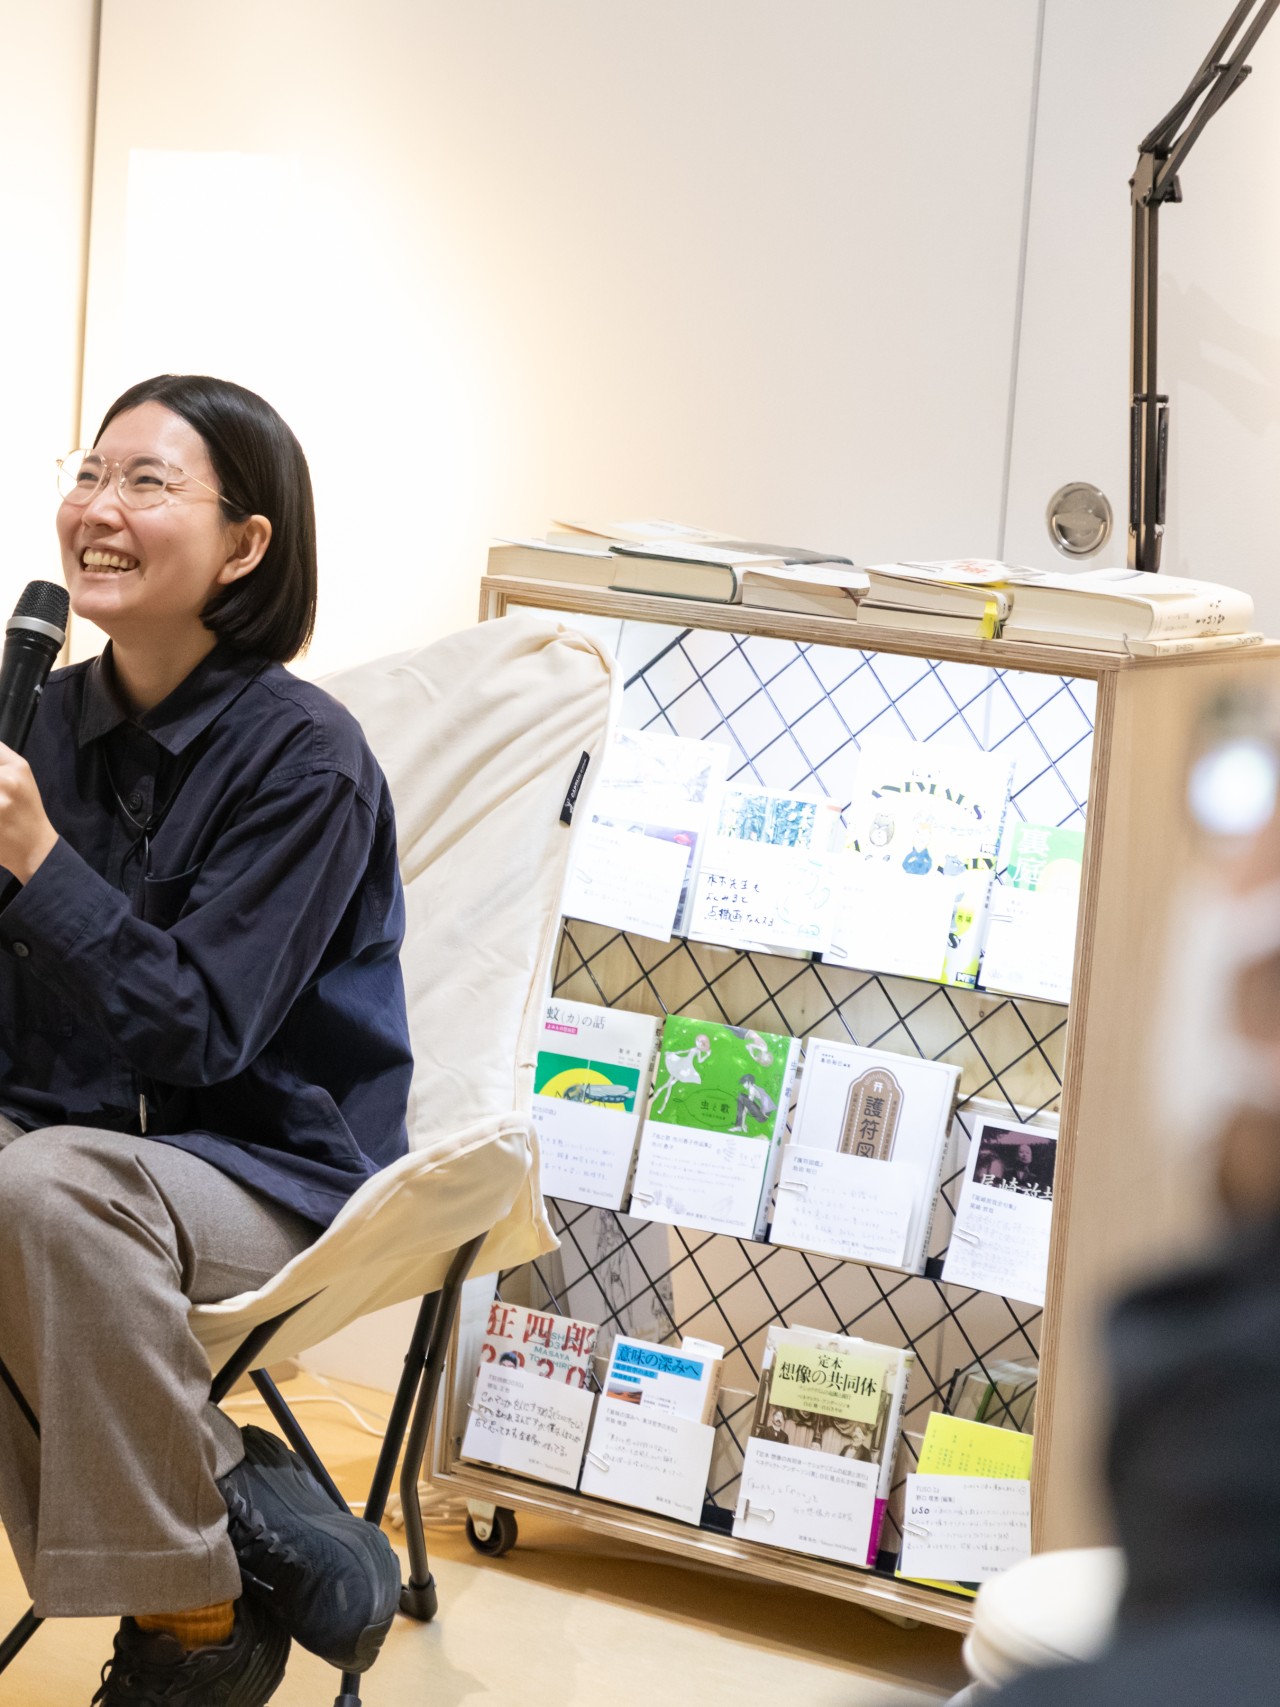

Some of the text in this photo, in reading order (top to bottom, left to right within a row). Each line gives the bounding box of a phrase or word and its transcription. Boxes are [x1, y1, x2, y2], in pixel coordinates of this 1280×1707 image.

[1012, 827, 1053, 886] 裏庭
[700, 1099, 731, 1115] 虫と歌
[486, 1304, 596, 1357] 狂四郎
[534, 1345, 571, 1362] MASAYA
[618, 1344, 700, 1377] 意味の深みへ
[818, 1354, 843, 1370] 定本
[778, 1361, 879, 1397] 想像の共同体
[911, 1505, 930, 1516] USO
